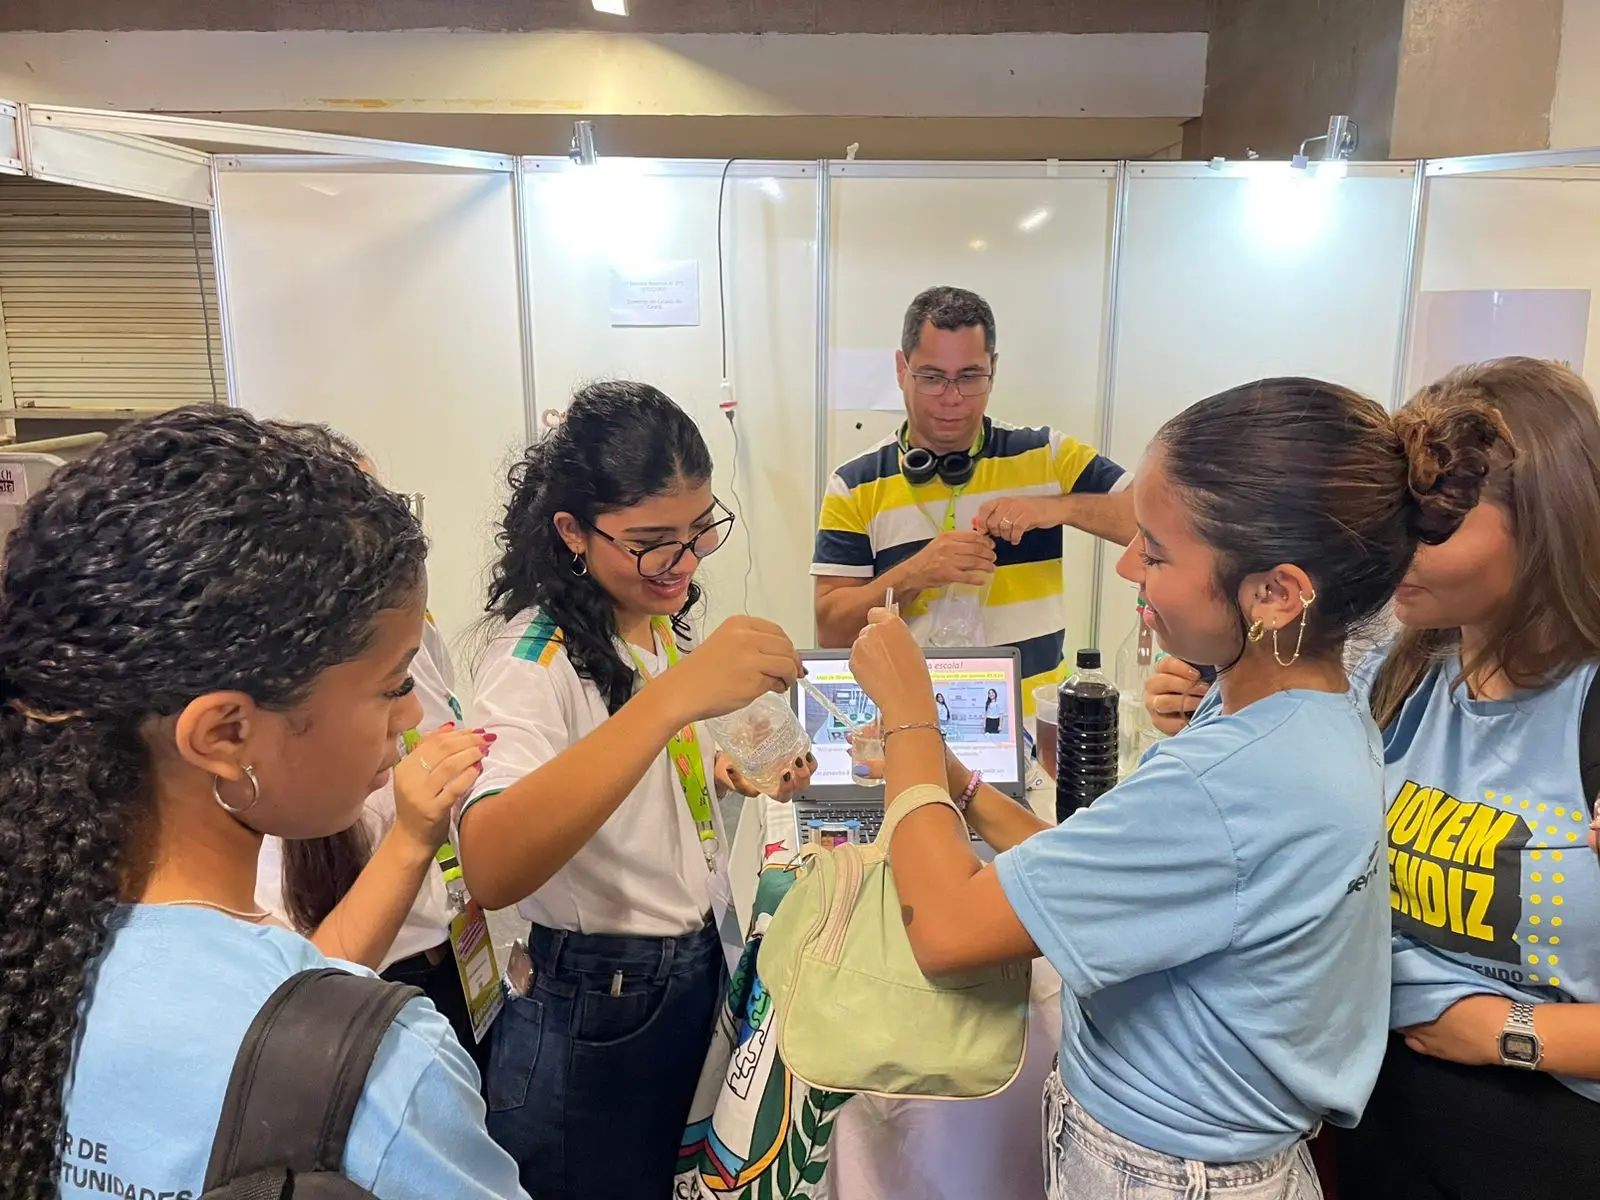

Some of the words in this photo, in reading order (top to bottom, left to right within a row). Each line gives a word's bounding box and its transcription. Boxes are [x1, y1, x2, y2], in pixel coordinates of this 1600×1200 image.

[935, 661, 963, 669] escola!
[1386, 781, 1518, 869] JOVEM
[1388, 848, 1495, 941] ENDIZ
[78, 1137, 107, 1164] DE
[63, 1161, 192, 1200] TUNIDADES
